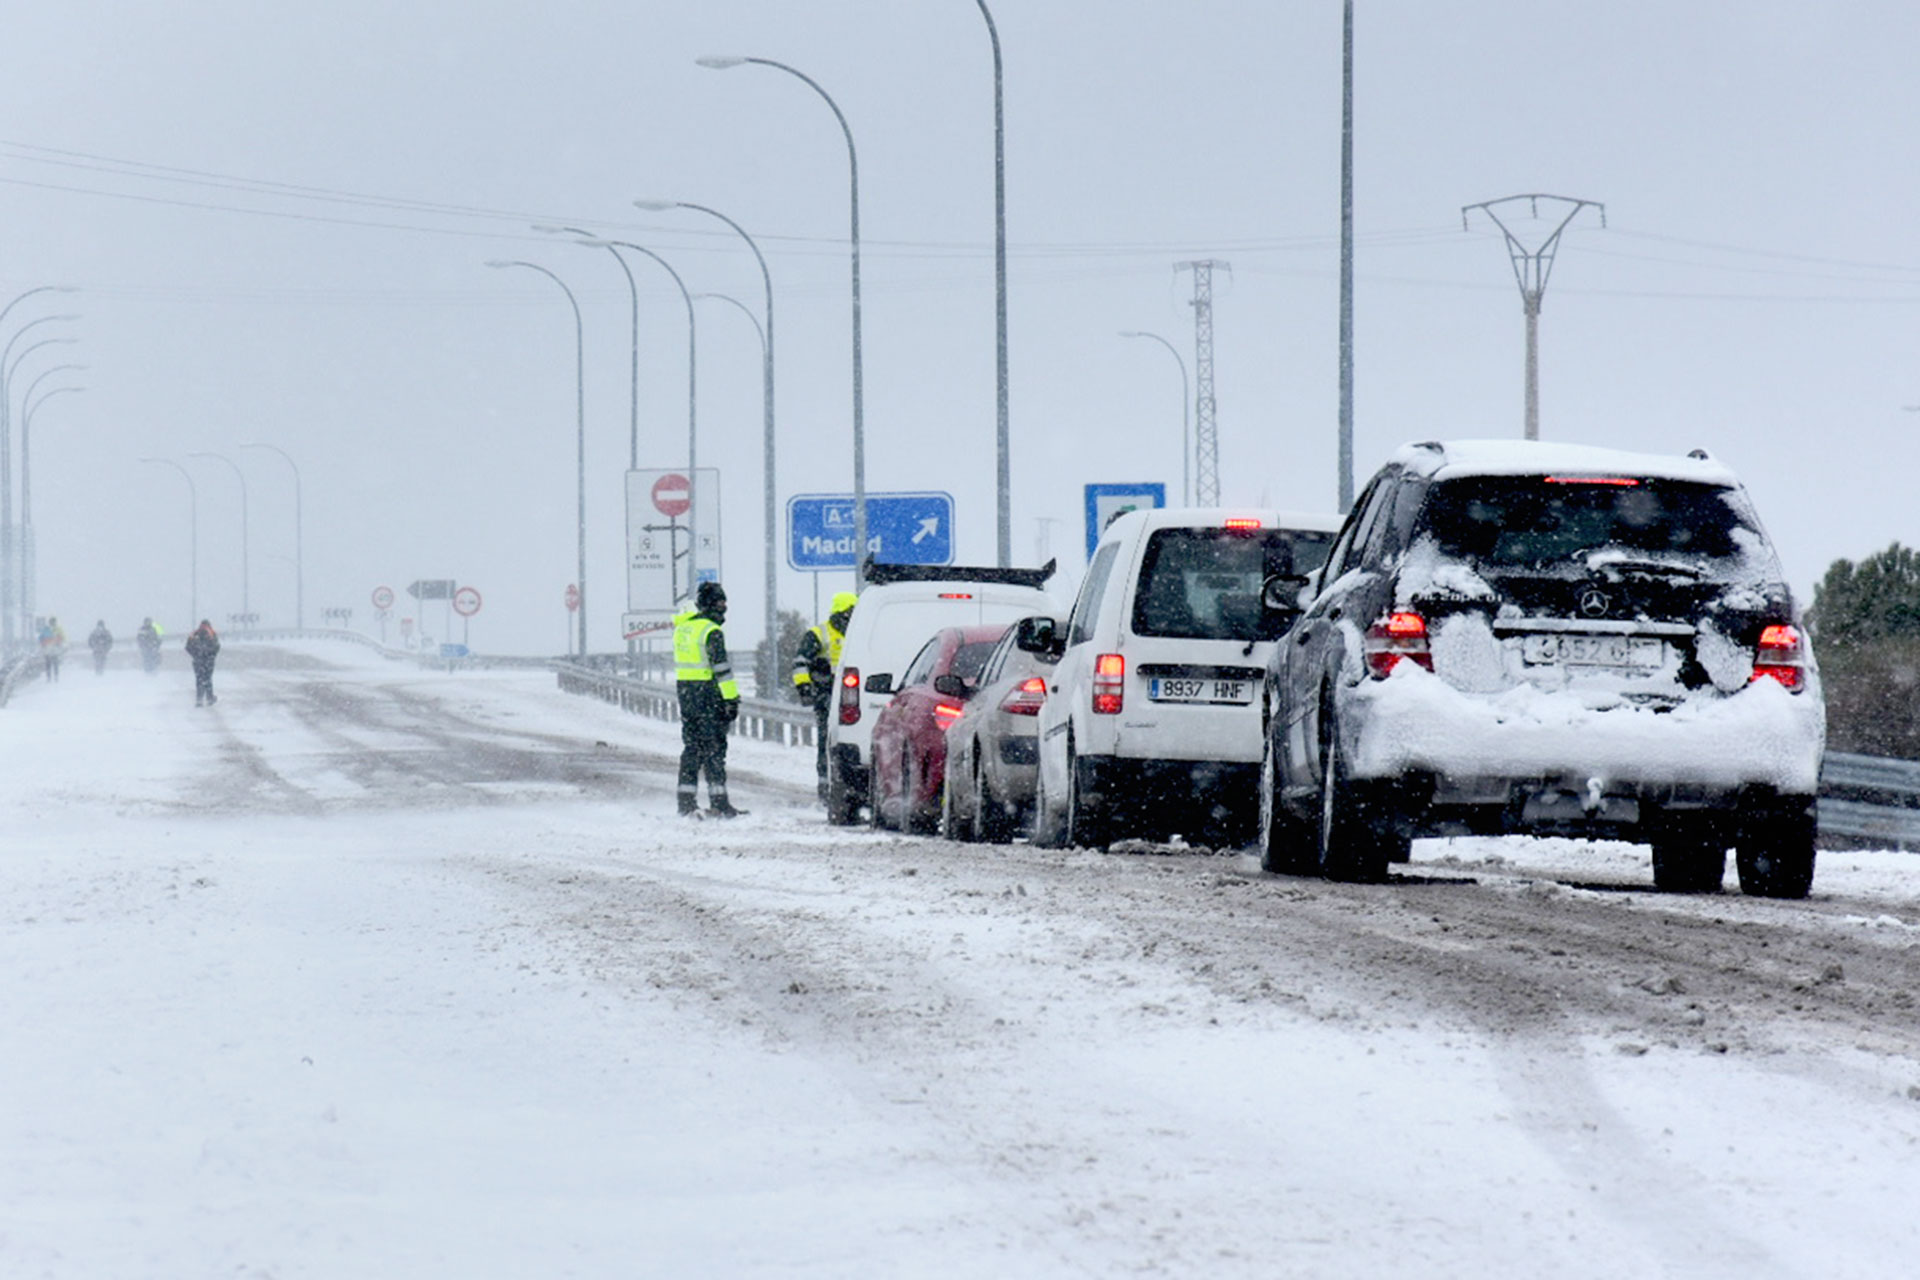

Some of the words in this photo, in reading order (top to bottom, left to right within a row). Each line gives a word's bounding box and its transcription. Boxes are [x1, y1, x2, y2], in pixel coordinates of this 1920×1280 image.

[802, 536, 882, 555] Madrd
[1164, 680, 1204, 697] 8937
[1214, 682, 1244, 699] HNF
